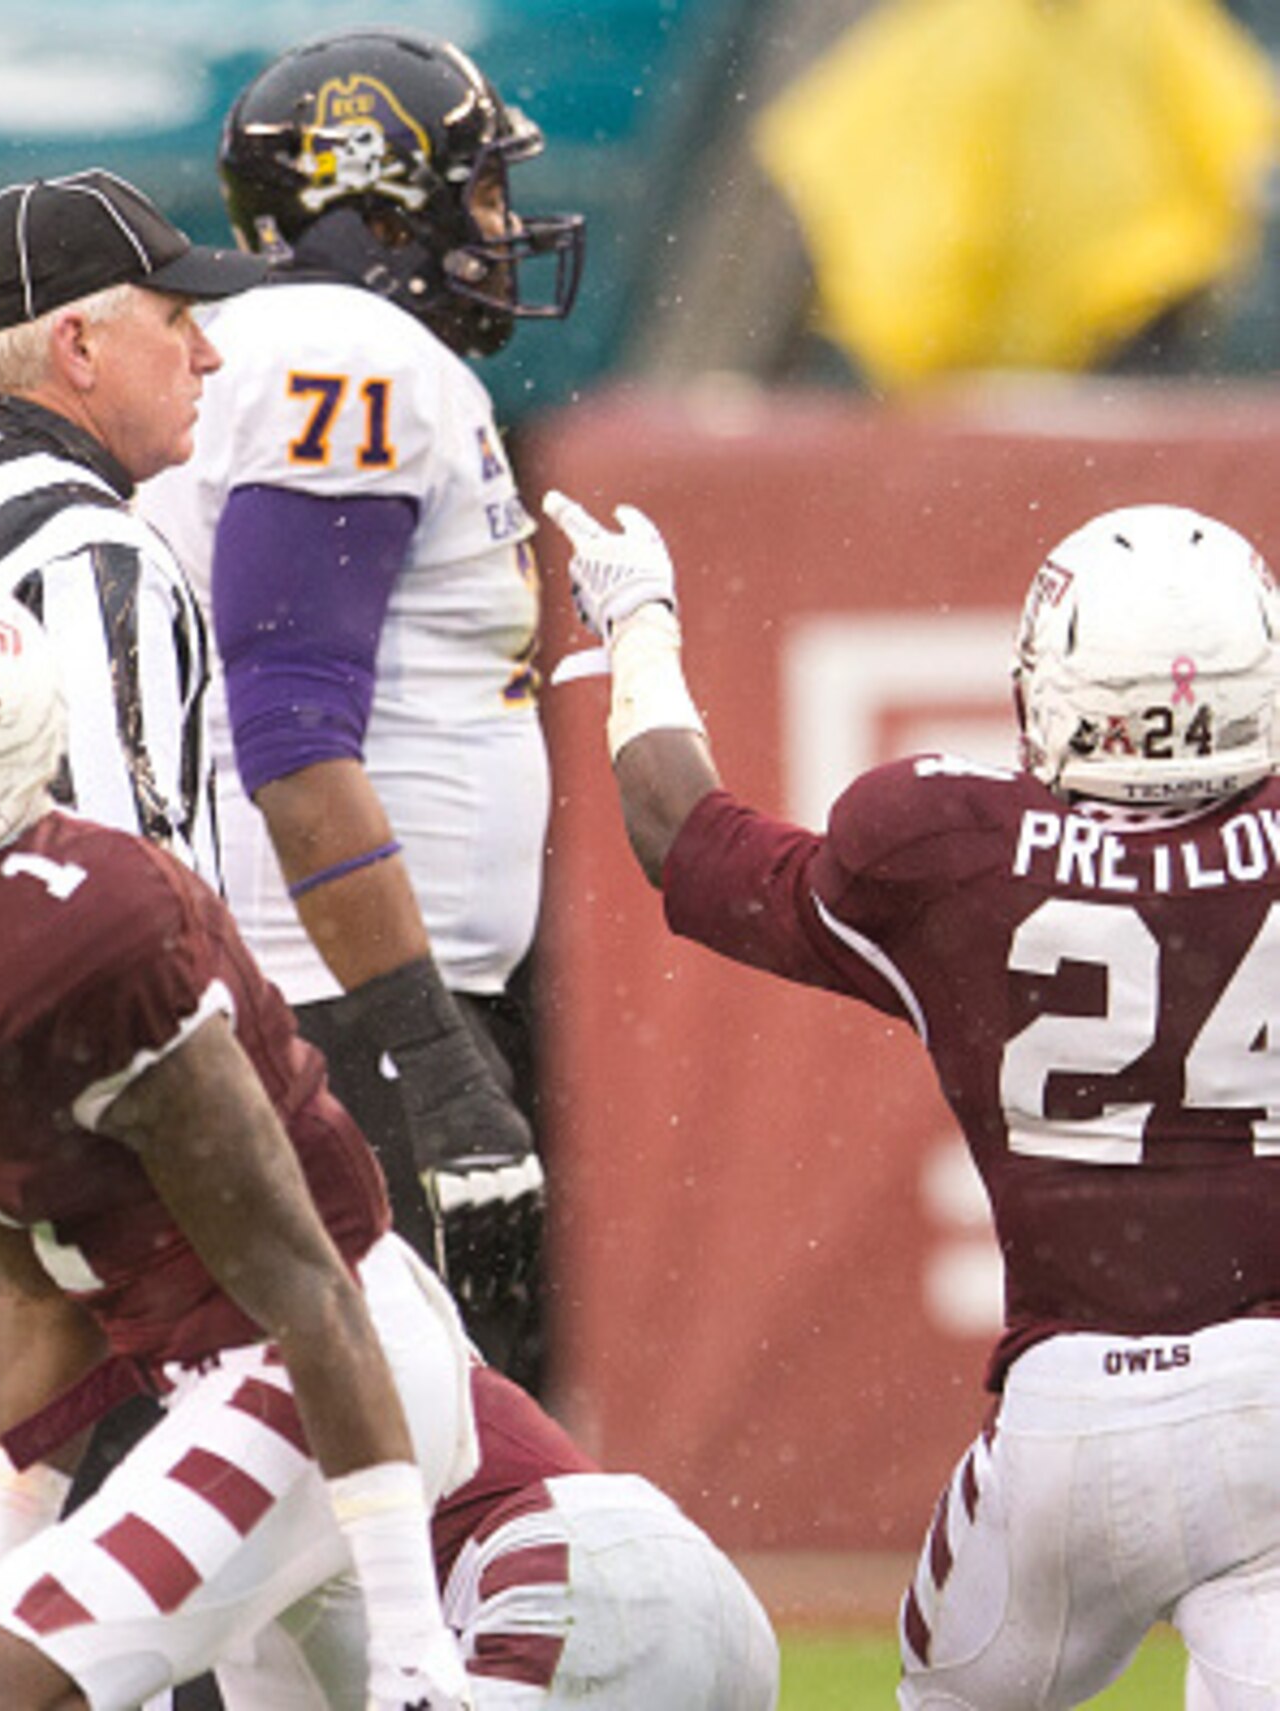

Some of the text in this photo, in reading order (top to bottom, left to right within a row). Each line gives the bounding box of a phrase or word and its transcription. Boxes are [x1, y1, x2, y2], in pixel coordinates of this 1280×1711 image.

[286, 369, 398, 472] 71
[1141, 704, 1214, 760] 24
[1123, 777, 1238, 798] TEMPLE
[0, 852, 88, 900] 1
[999, 897, 1280, 1165] 24
[1103, 1343, 1192, 1376] OWLS
